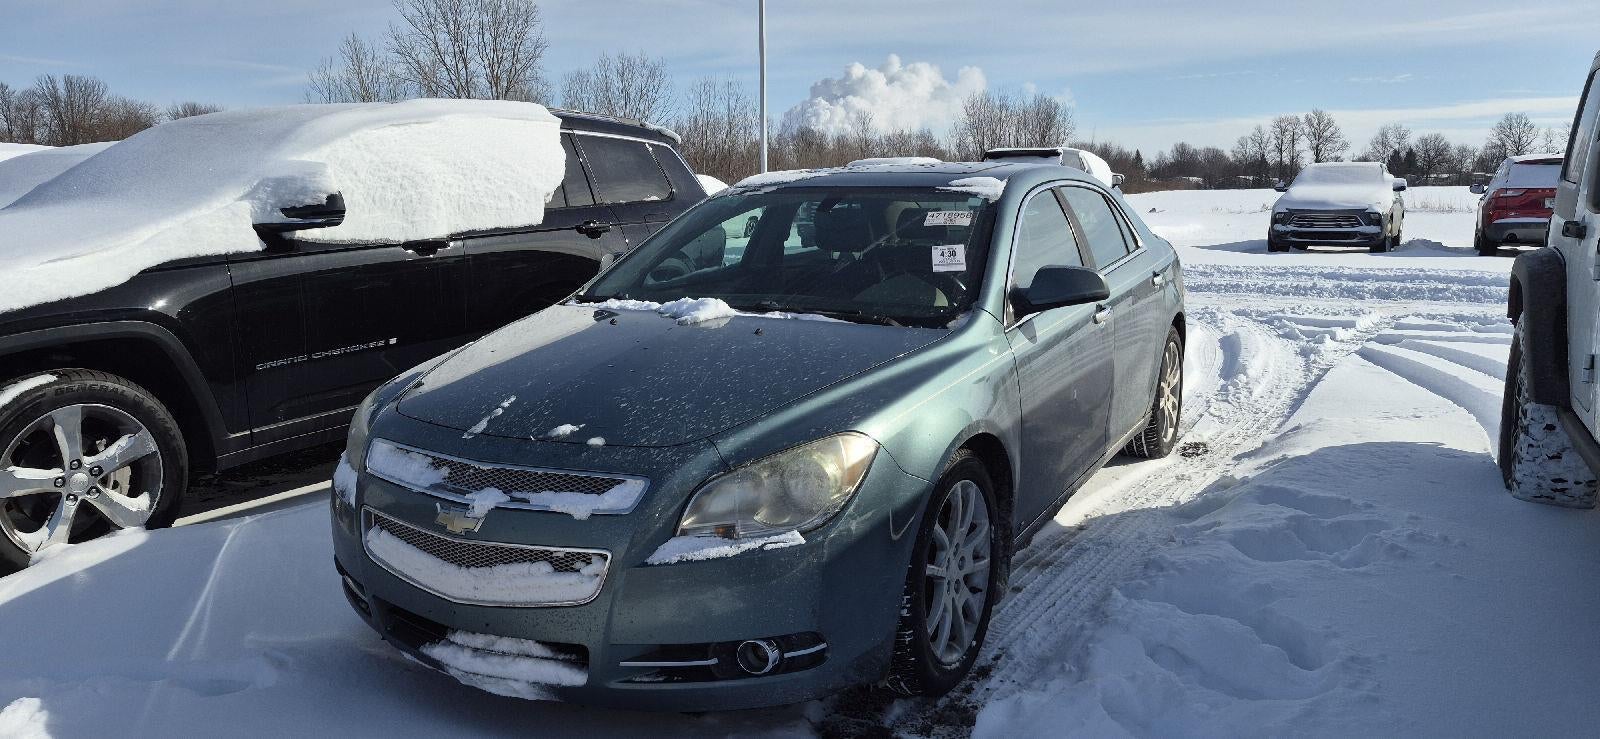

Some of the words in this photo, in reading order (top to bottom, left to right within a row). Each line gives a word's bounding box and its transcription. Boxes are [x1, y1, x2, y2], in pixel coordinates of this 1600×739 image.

[256, 354, 308, 370] GRAND
[311, 340, 385, 359] CHEROKEE
[54, 383, 128, 396] GENERAL
